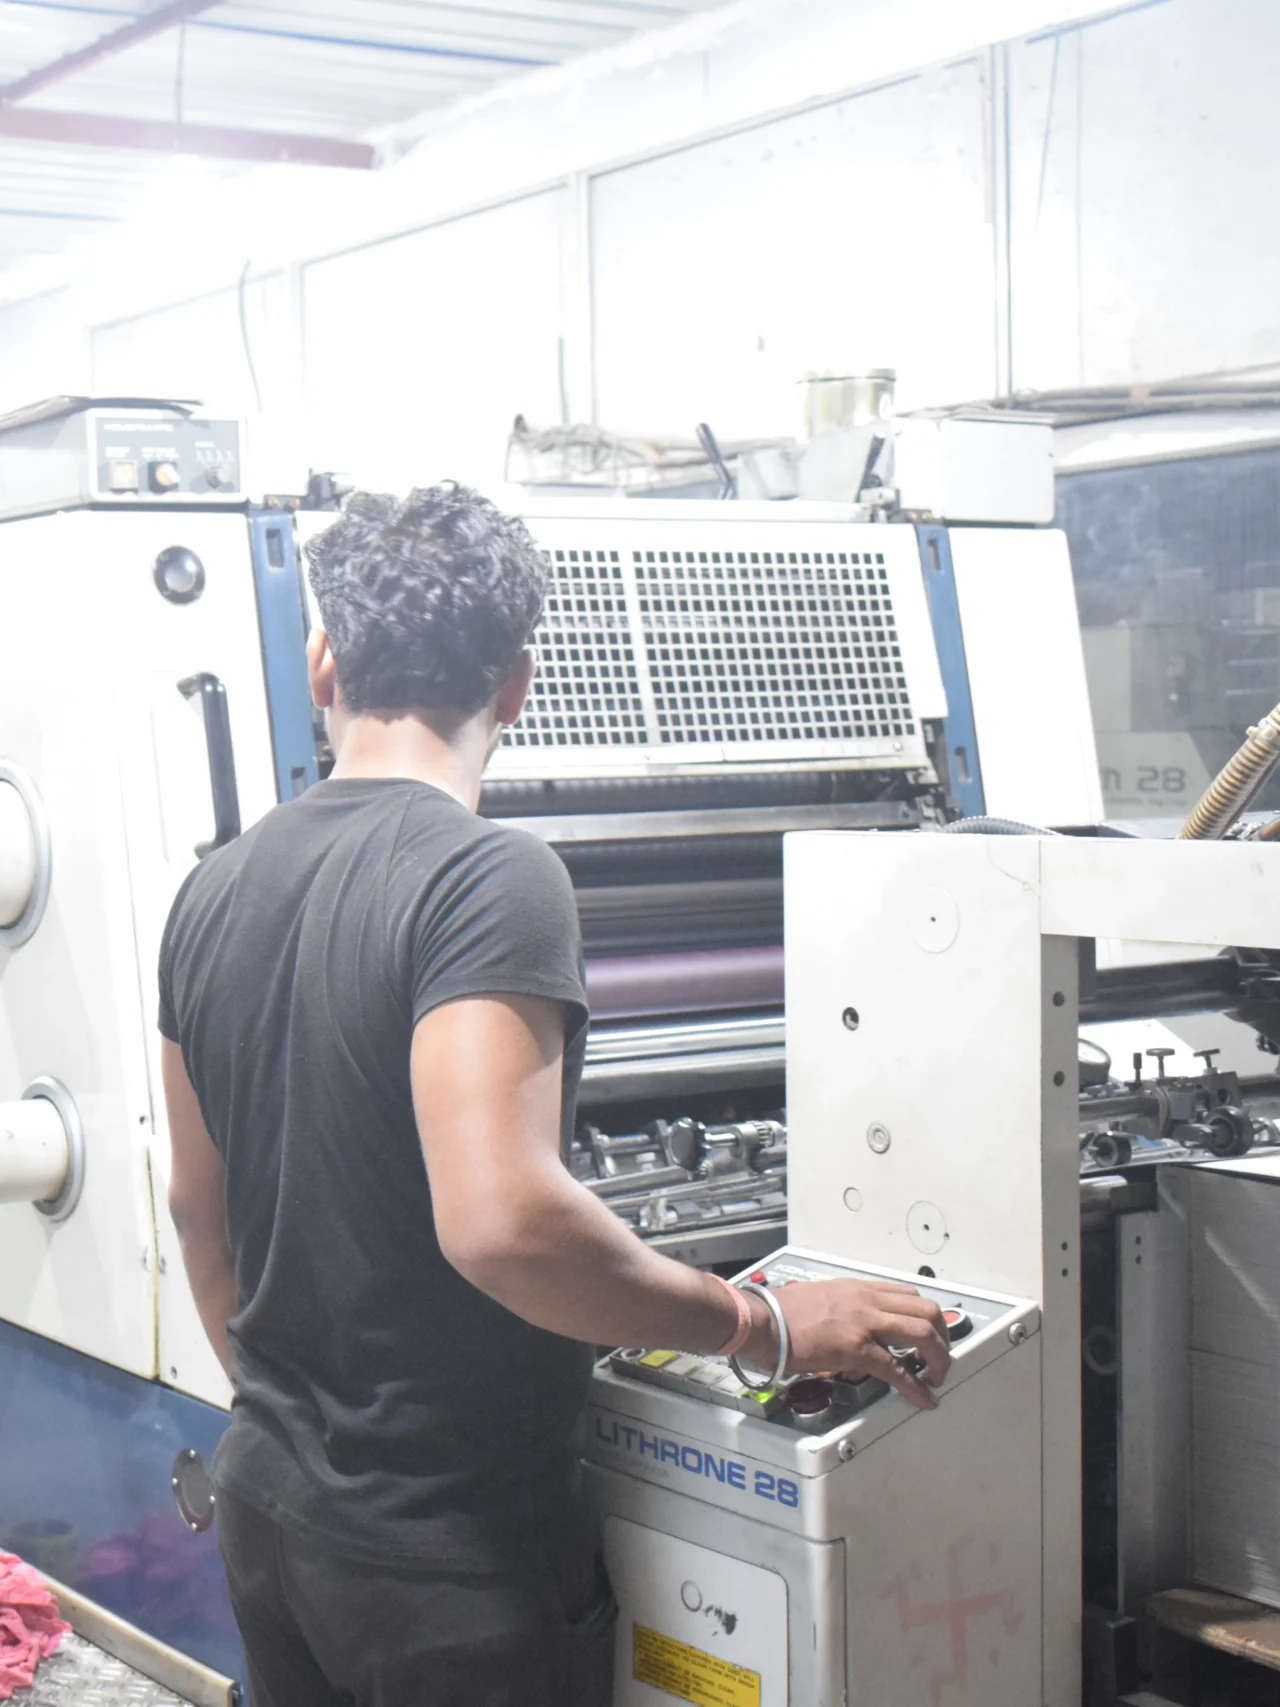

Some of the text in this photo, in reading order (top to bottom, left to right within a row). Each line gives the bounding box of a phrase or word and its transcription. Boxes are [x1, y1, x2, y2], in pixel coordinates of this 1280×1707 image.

[1136, 766, 1186, 793] 28
[596, 1417, 747, 1491] LITHRONE
[754, 1471, 800, 1509] 28
